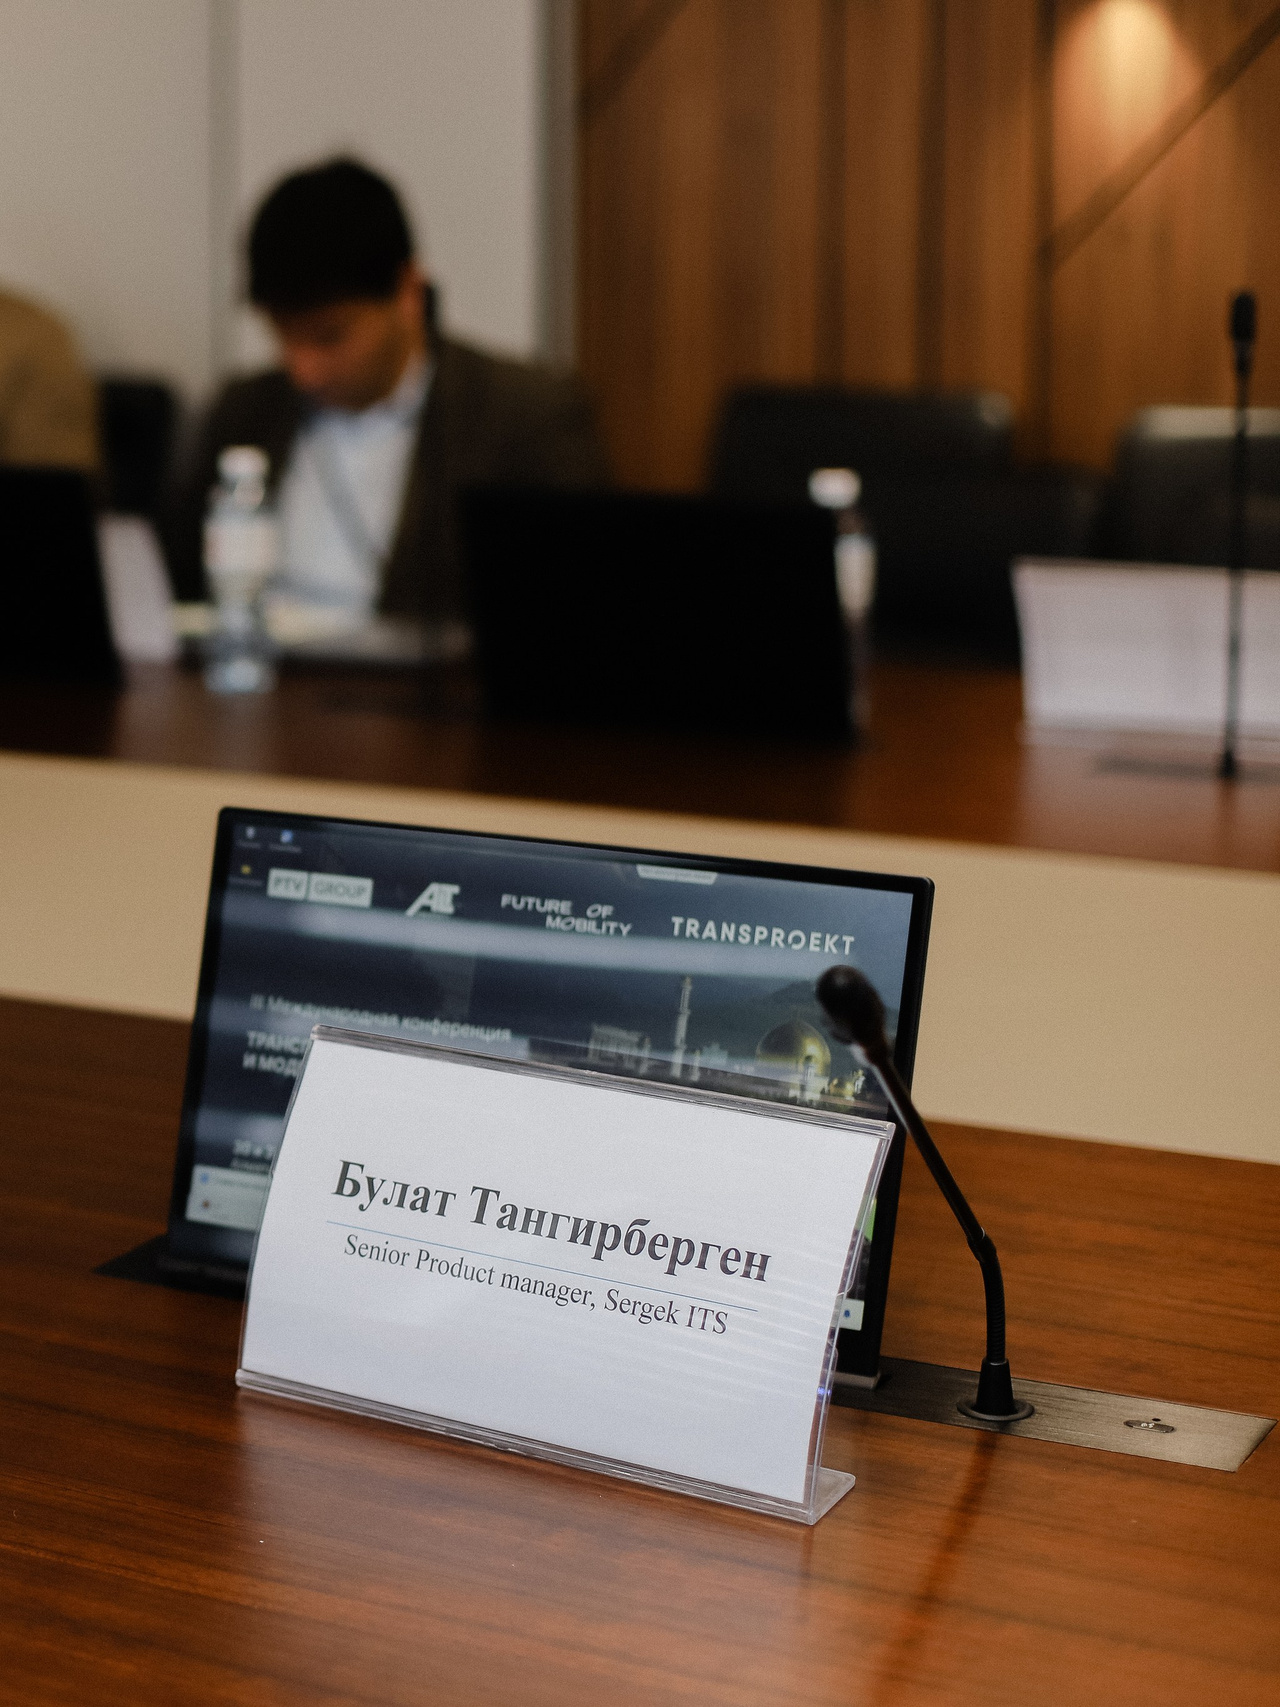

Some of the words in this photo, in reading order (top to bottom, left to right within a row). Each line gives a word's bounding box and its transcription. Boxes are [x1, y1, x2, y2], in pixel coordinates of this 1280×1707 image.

[313, 880, 367, 899] GROUP
[501, 893, 572, 916] FUTURE
[586, 903, 614, 919] OF
[545, 914, 632, 937] MOBILITY
[671, 915, 855, 955] TRANSPROEKT
[332, 1159, 457, 1217] Булат
[469, 1185, 773, 1282] Тангирберген
[344, 1234, 411, 1267] Senior
[414, 1248, 497, 1286] Product
[500, 1270, 597, 1312] manager,
[604, 1288, 680, 1326] Sergek
[685, 1305, 729, 1335] ITS
